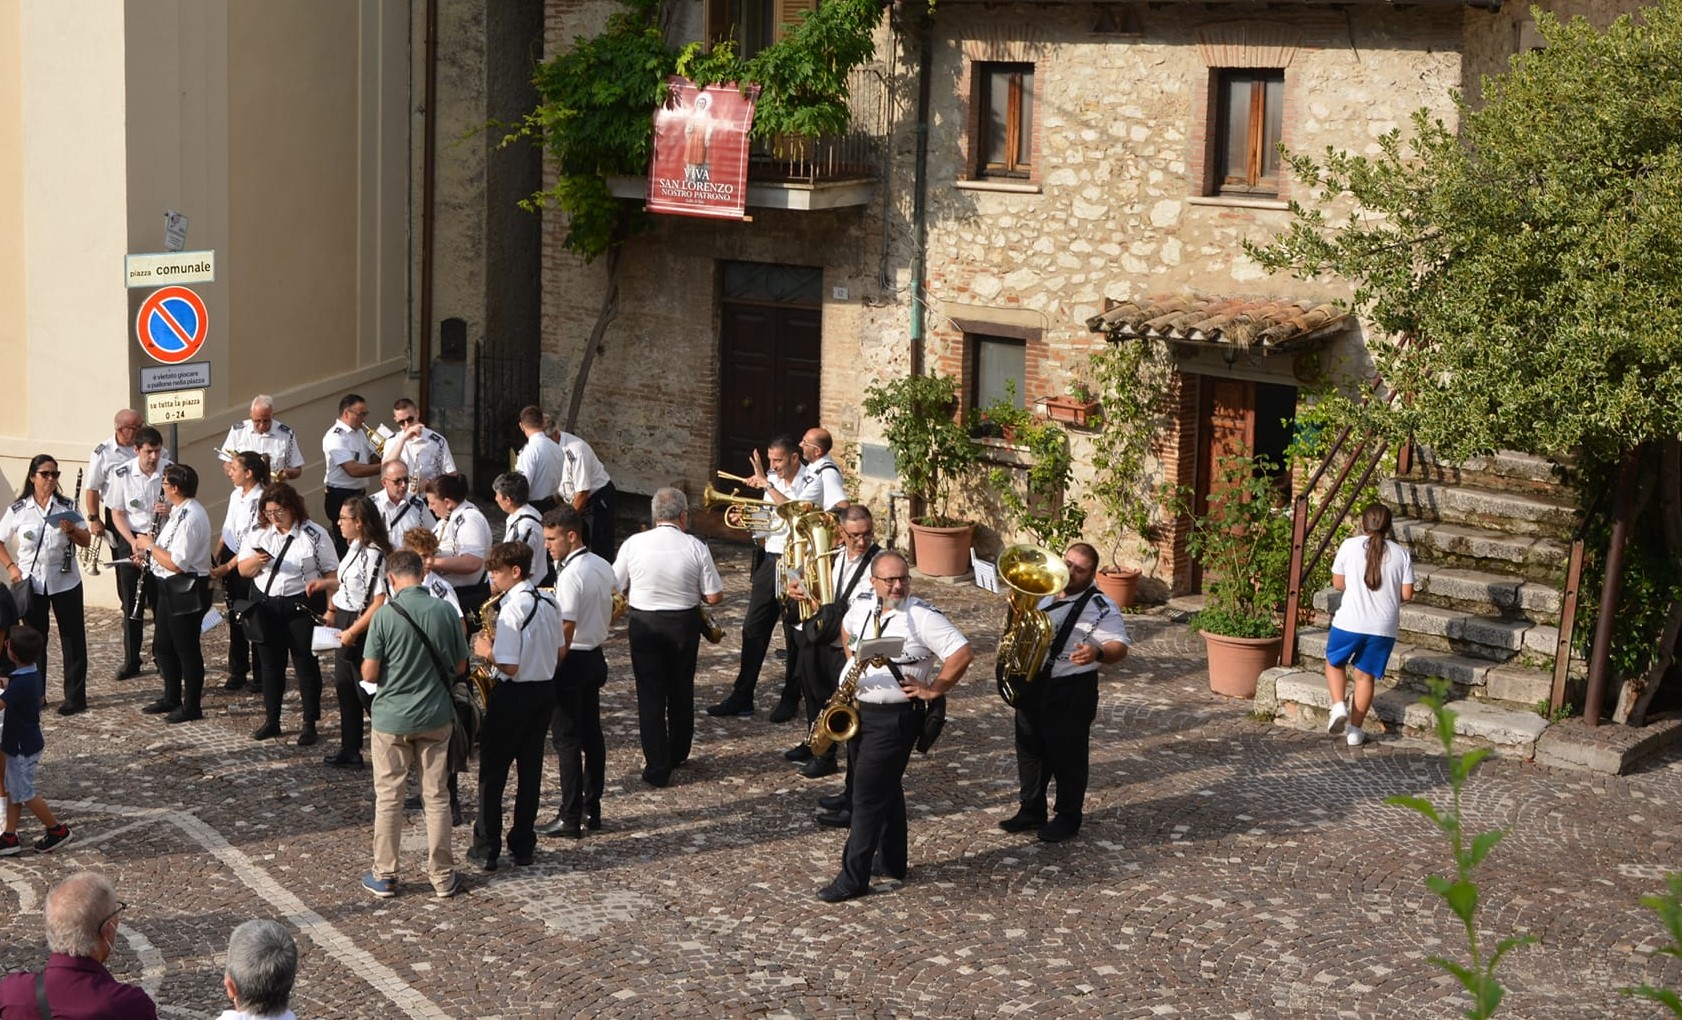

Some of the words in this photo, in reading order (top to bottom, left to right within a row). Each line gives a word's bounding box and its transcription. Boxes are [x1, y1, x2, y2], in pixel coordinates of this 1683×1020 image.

[684, 167, 710, 180] VIVA
[660, 179, 679, 189] SAN
[682, 181, 734, 194] LORENZO
[662, 189, 692, 198] NOSTRO
[694, 191, 730, 200] PATRONO
[156, 261, 211, 275] comunale
[157, 372, 177, 380] vietato
[178, 371, 199, 379] giocare
[152, 380, 172, 389] pallone
[187, 377, 205, 385] piazza
[159, 401, 173, 409] tutta
[175, 399, 181, 407] la
[182, 399, 200, 407] piazza
